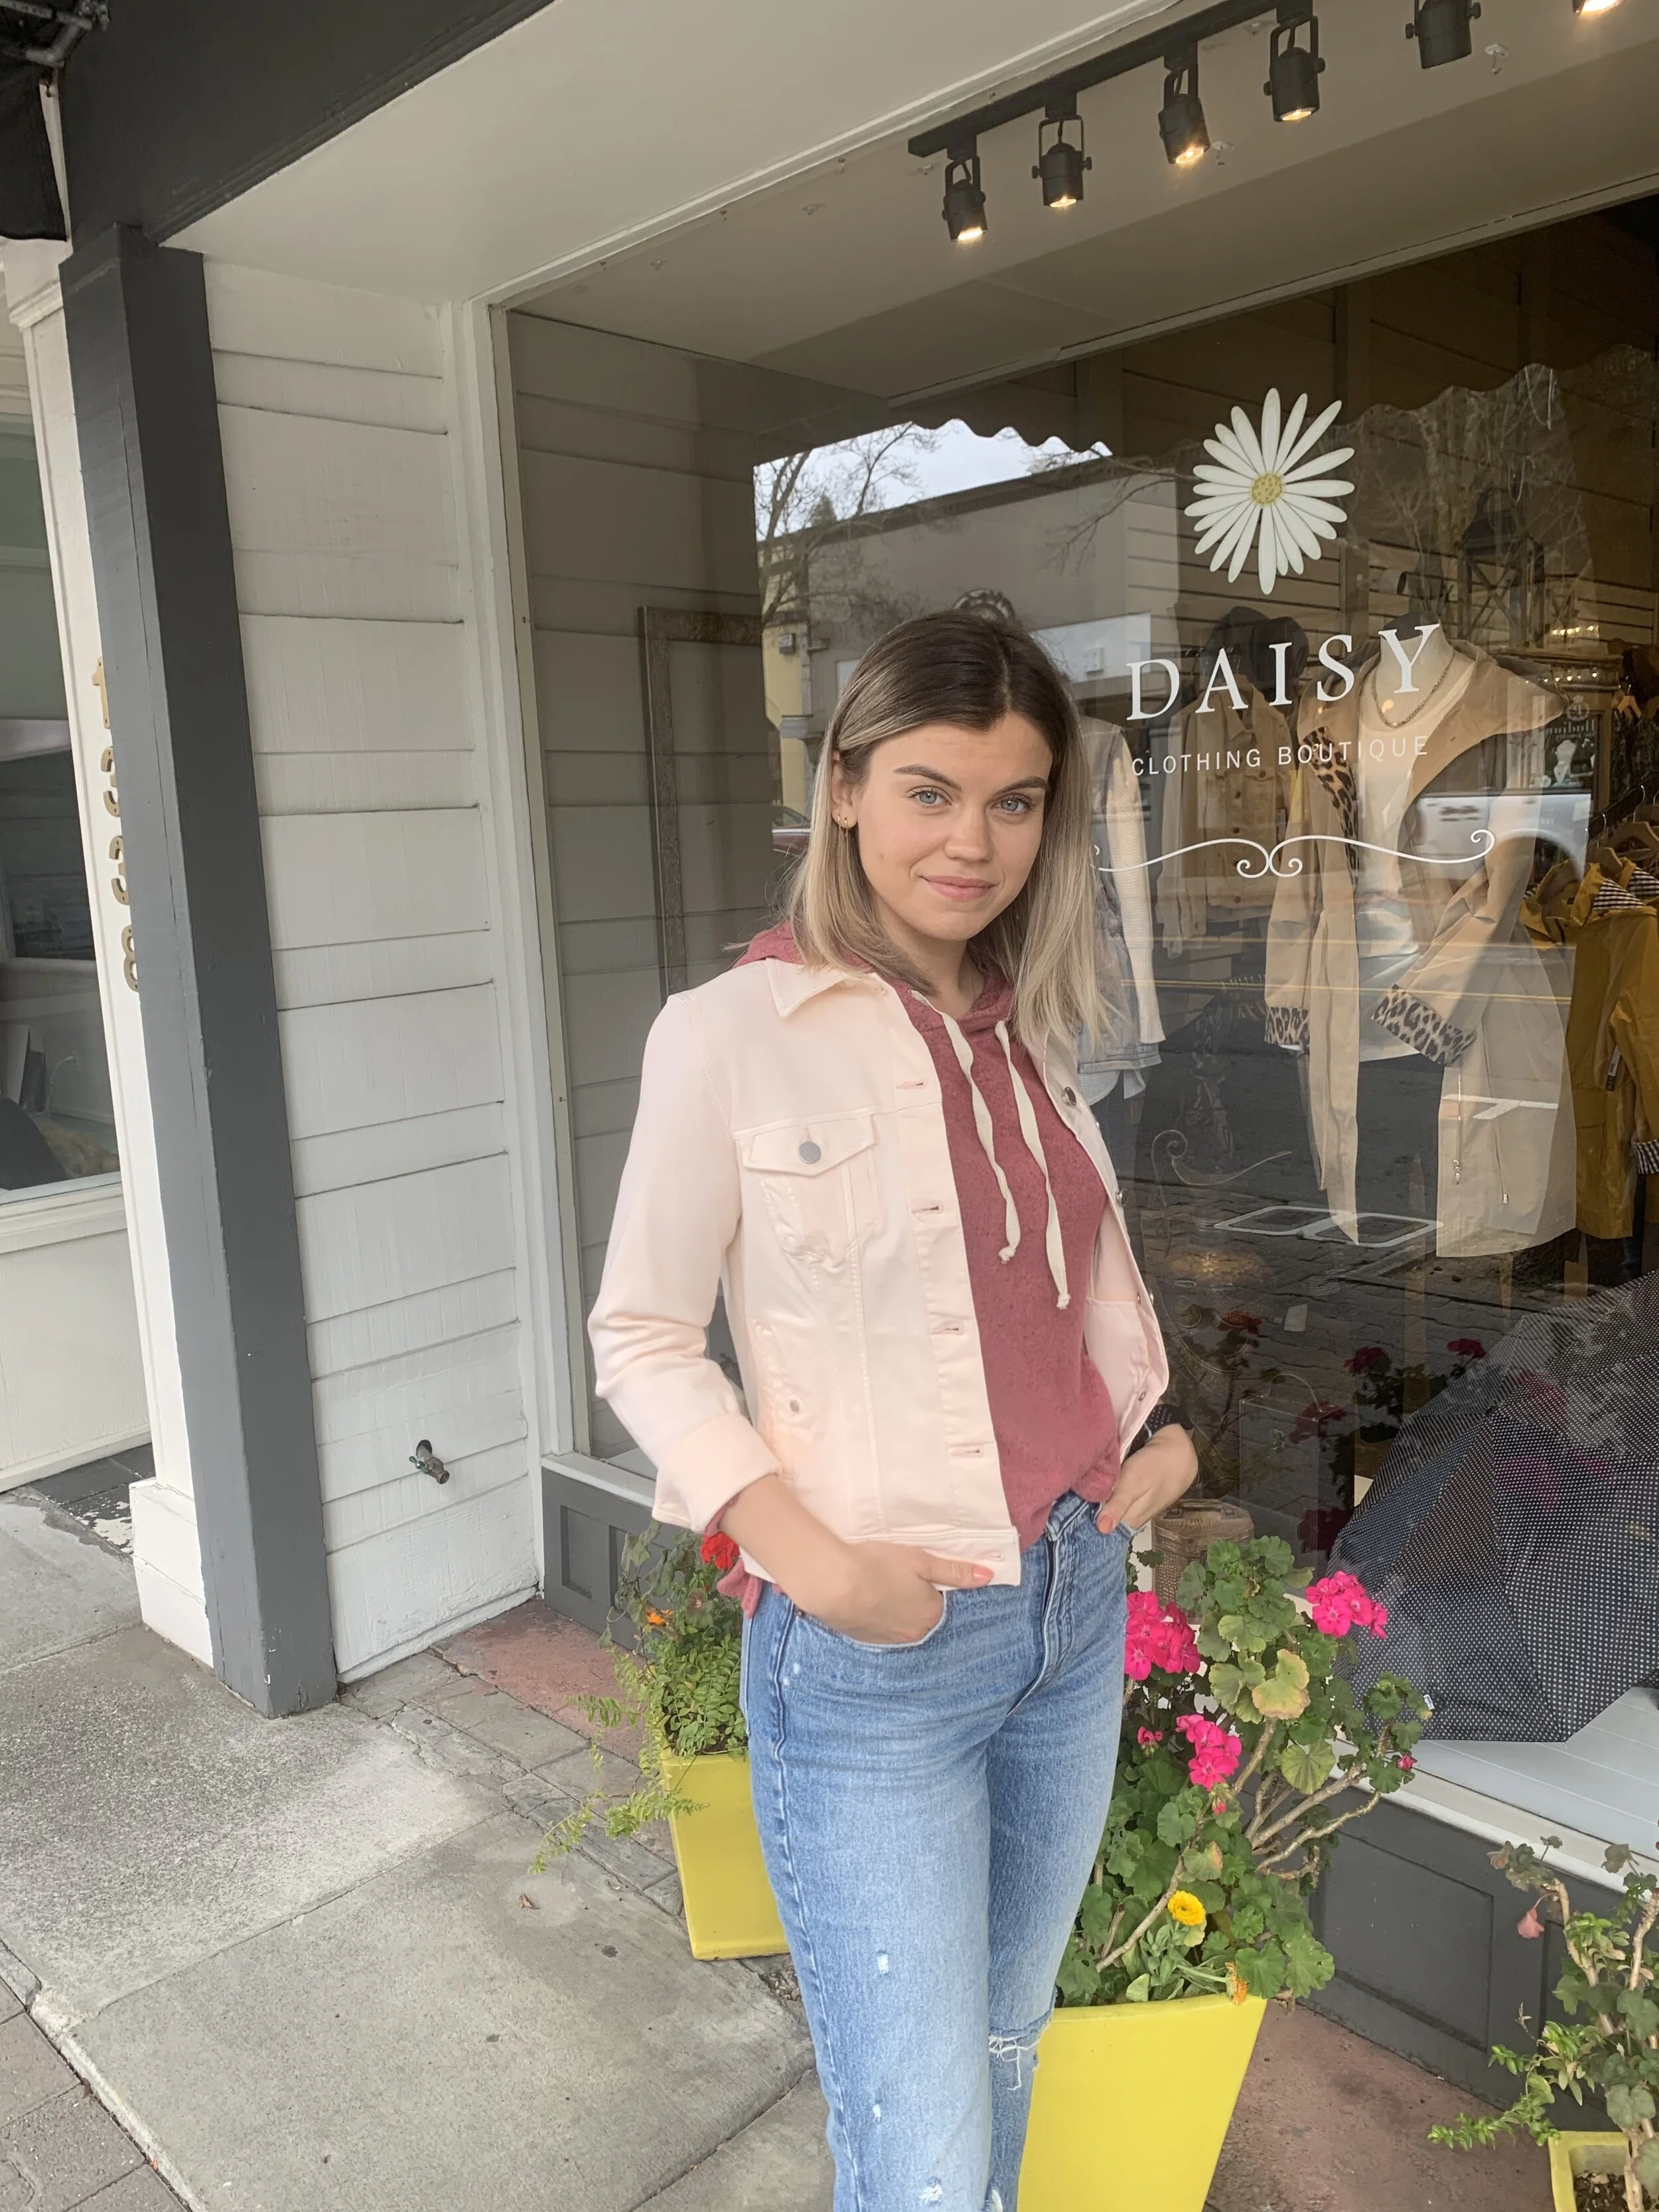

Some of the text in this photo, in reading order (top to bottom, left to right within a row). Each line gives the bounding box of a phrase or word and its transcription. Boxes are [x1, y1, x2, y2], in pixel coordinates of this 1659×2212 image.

[1126, 623, 1440, 721] DAISY
[1131, 735, 1428, 776] CLOTHING BOUTIQUE
